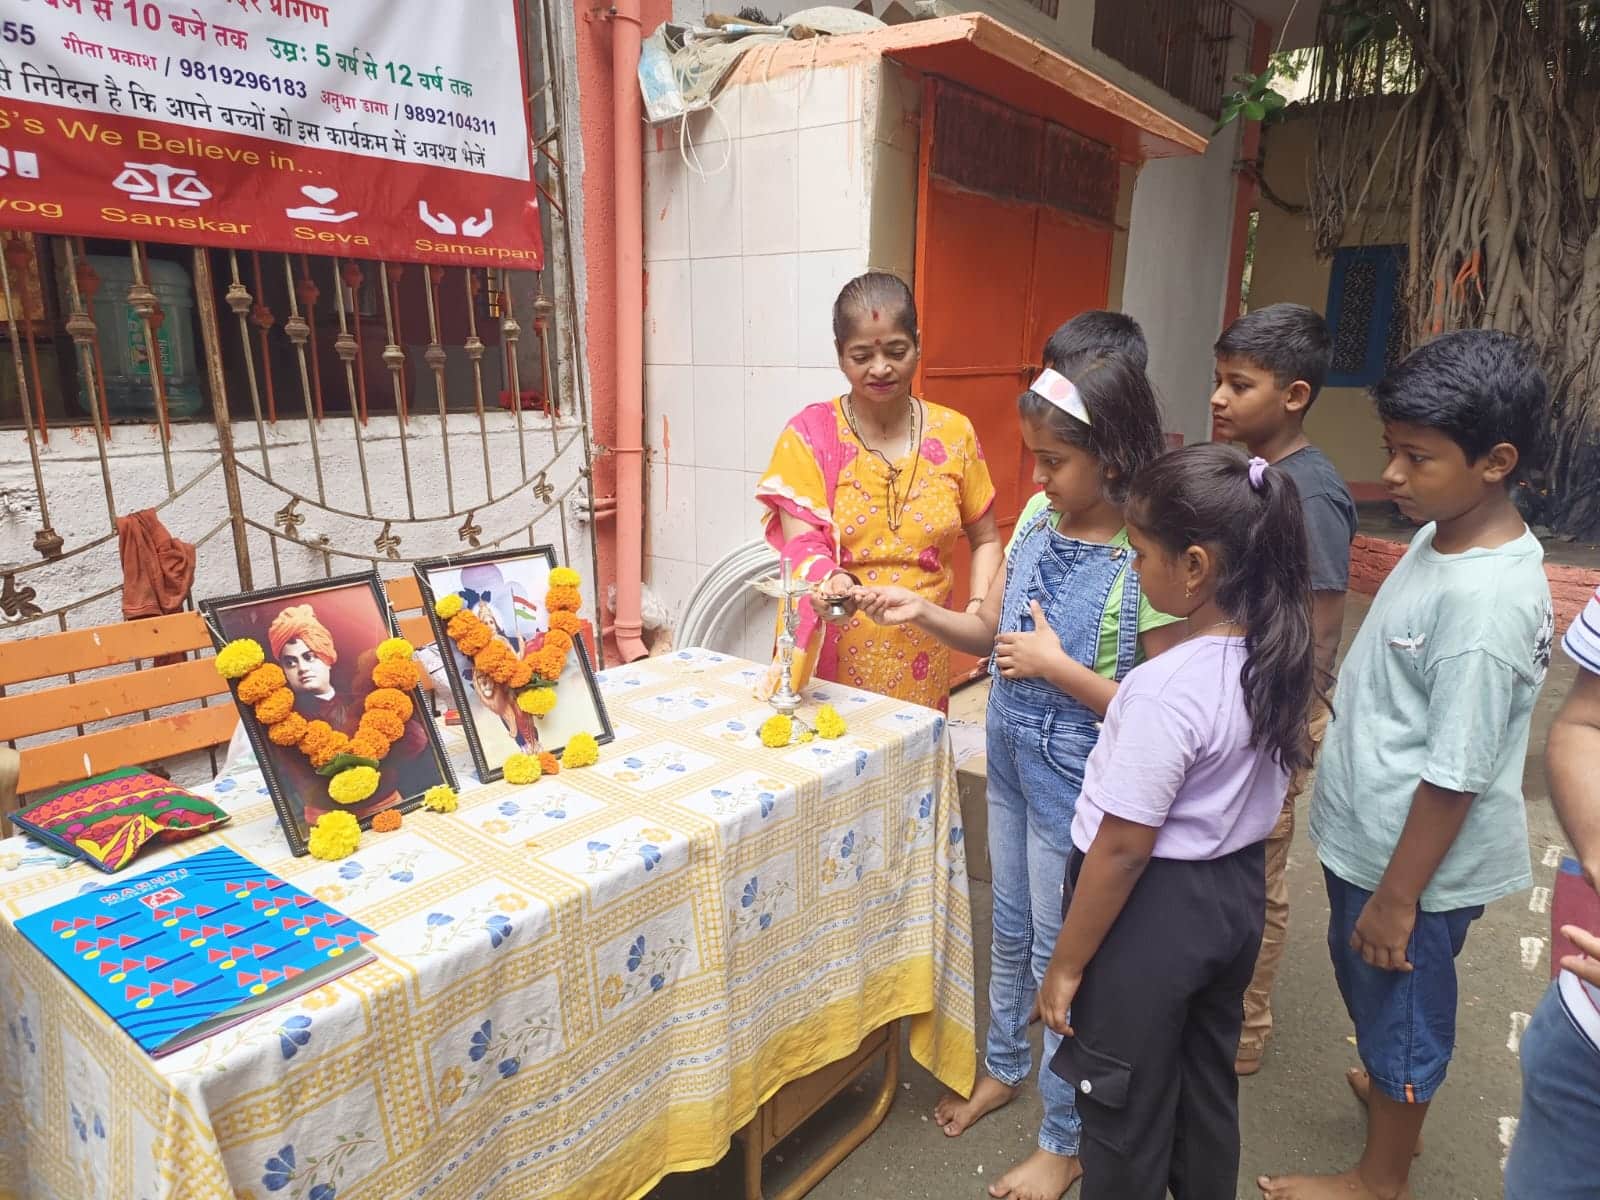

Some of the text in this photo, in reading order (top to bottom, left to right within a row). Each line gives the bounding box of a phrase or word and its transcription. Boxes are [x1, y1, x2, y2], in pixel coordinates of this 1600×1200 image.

[0, 21, 36, 46] 55
[270, 0, 329, 27] प्रागण
[61, 31, 104, 59] गीता
[107, 46, 157, 71] प्रकाश
[179, 58, 307, 99] 9819296183
[93, 0, 114, 22] स
[123, 0, 161, 31] 10
[168, 9, 207, 41] बजे
[212, 24, 248, 51] तक
[316, 43, 331, 67] 5
[335, 48, 358, 75] वर्ष
[362, 53, 378, 80] से
[385, 62, 413, 87] 12
[417, 66, 444, 92] वर्ष
[448, 78, 473, 98] तक
[19, 62, 99, 104] निवेदन
[104, 74, 123, 112] है
[127, 80, 157, 113] कि
[166, 92, 212, 123] अपने
[217, 101, 266, 132] बच्चों
[270, 107, 292, 137] को
[297, 120, 320, 145] इस
[324, 122, 388, 153] कार्यक्रम
[391, 129, 407, 156] में
[413, 140, 457, 164] अवश्य
[461, 141, 486, 169] भेजें
[404, 104, 497, 136] 9892104311
[57, 118, 123, 146] We
[136, 130, 260, 165] Believe
[101, 207, 251, 235] Sanskar
[294, 227, 370, 246] Seva
[415, 239, 538, 260] Samarpan
